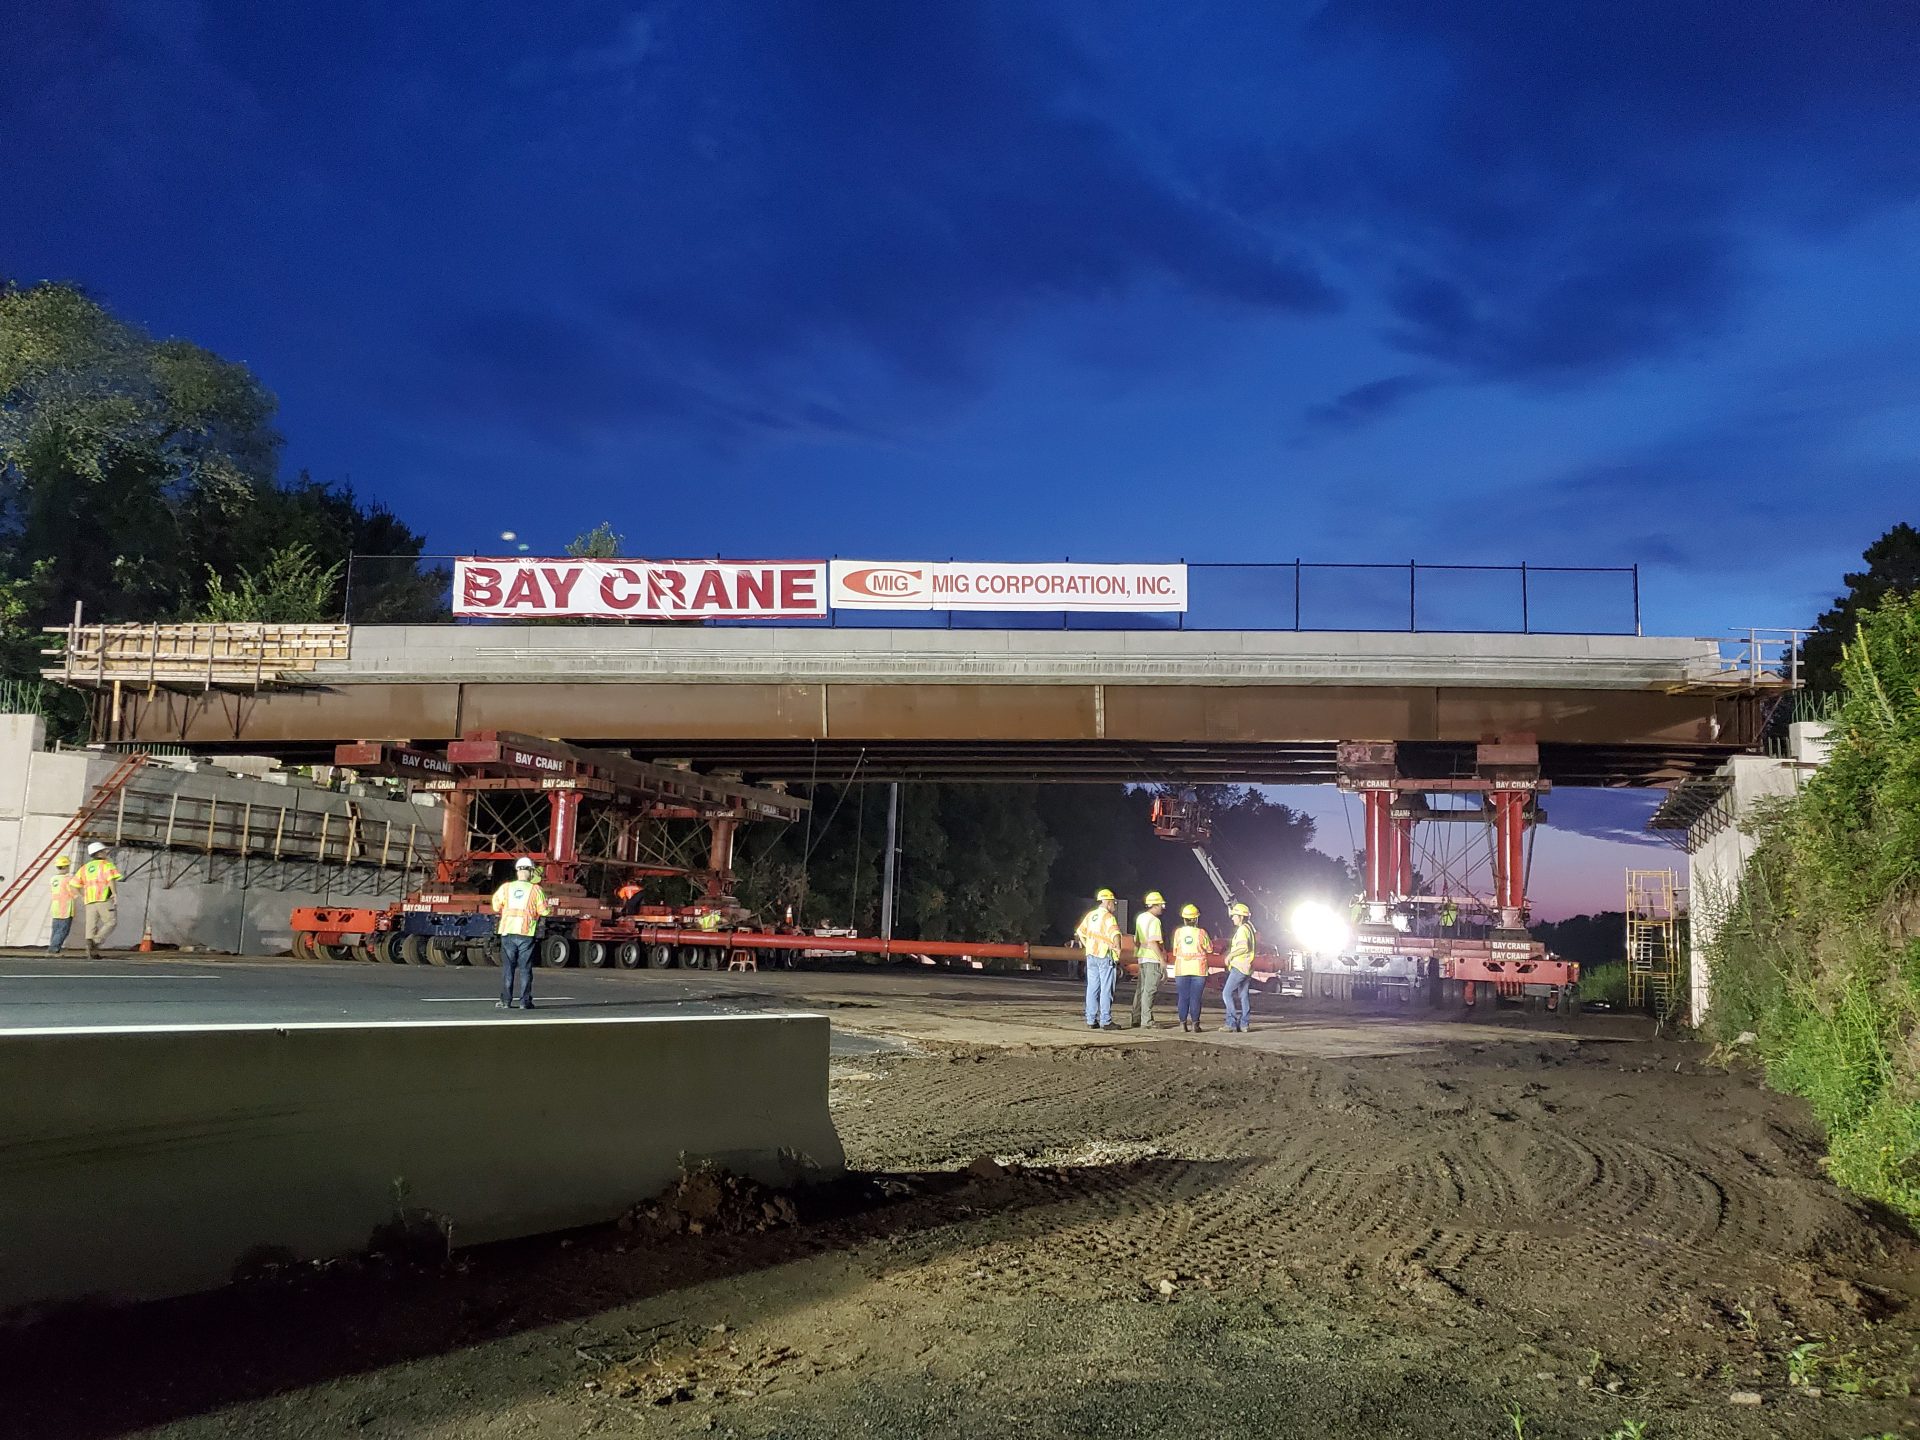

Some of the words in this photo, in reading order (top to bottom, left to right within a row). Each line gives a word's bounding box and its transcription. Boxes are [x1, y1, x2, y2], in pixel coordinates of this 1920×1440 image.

[872, 574, 909, 592] MIG
[933, 574, 970, 593] MIG
[975, 575, 1131, 598] CORPORATION,
[1136, 576, 1177, 595] INC.
[463, 567, 583, 609] BAY
[600, 567, 818, 610] CRANE
[402, 754, 421, 767] BAY
[423, 758, 452, 773] CRANE
[515, 752, 533, 766] BAY
[535, 756, 563, 772] CRANE
[425, 780, 437, 789] BAY
[437, 780, 456, 789] CRANE
[542, 779, 556, 788] BAY
[1366, 780, 1390, 788] CRANE
[1495, 781, 1510, 789] BAY
[1511, 781, 1535, 789] CRANE
[421, 895, 432, 903] BAY
[432, 895, 450, 903] CRANE
[403, 904, 414, 912] BAY
[413, 904, 432, 912] CRANE
[1372, 936, 1395, 945] CRANE
[1492, 941, 1507, 949] BAY
[1507, 942, 1531, 950] CRANE
[1491, 951, 1506, 959] BAY
[1506, 952, 1530, 960] CRANE
